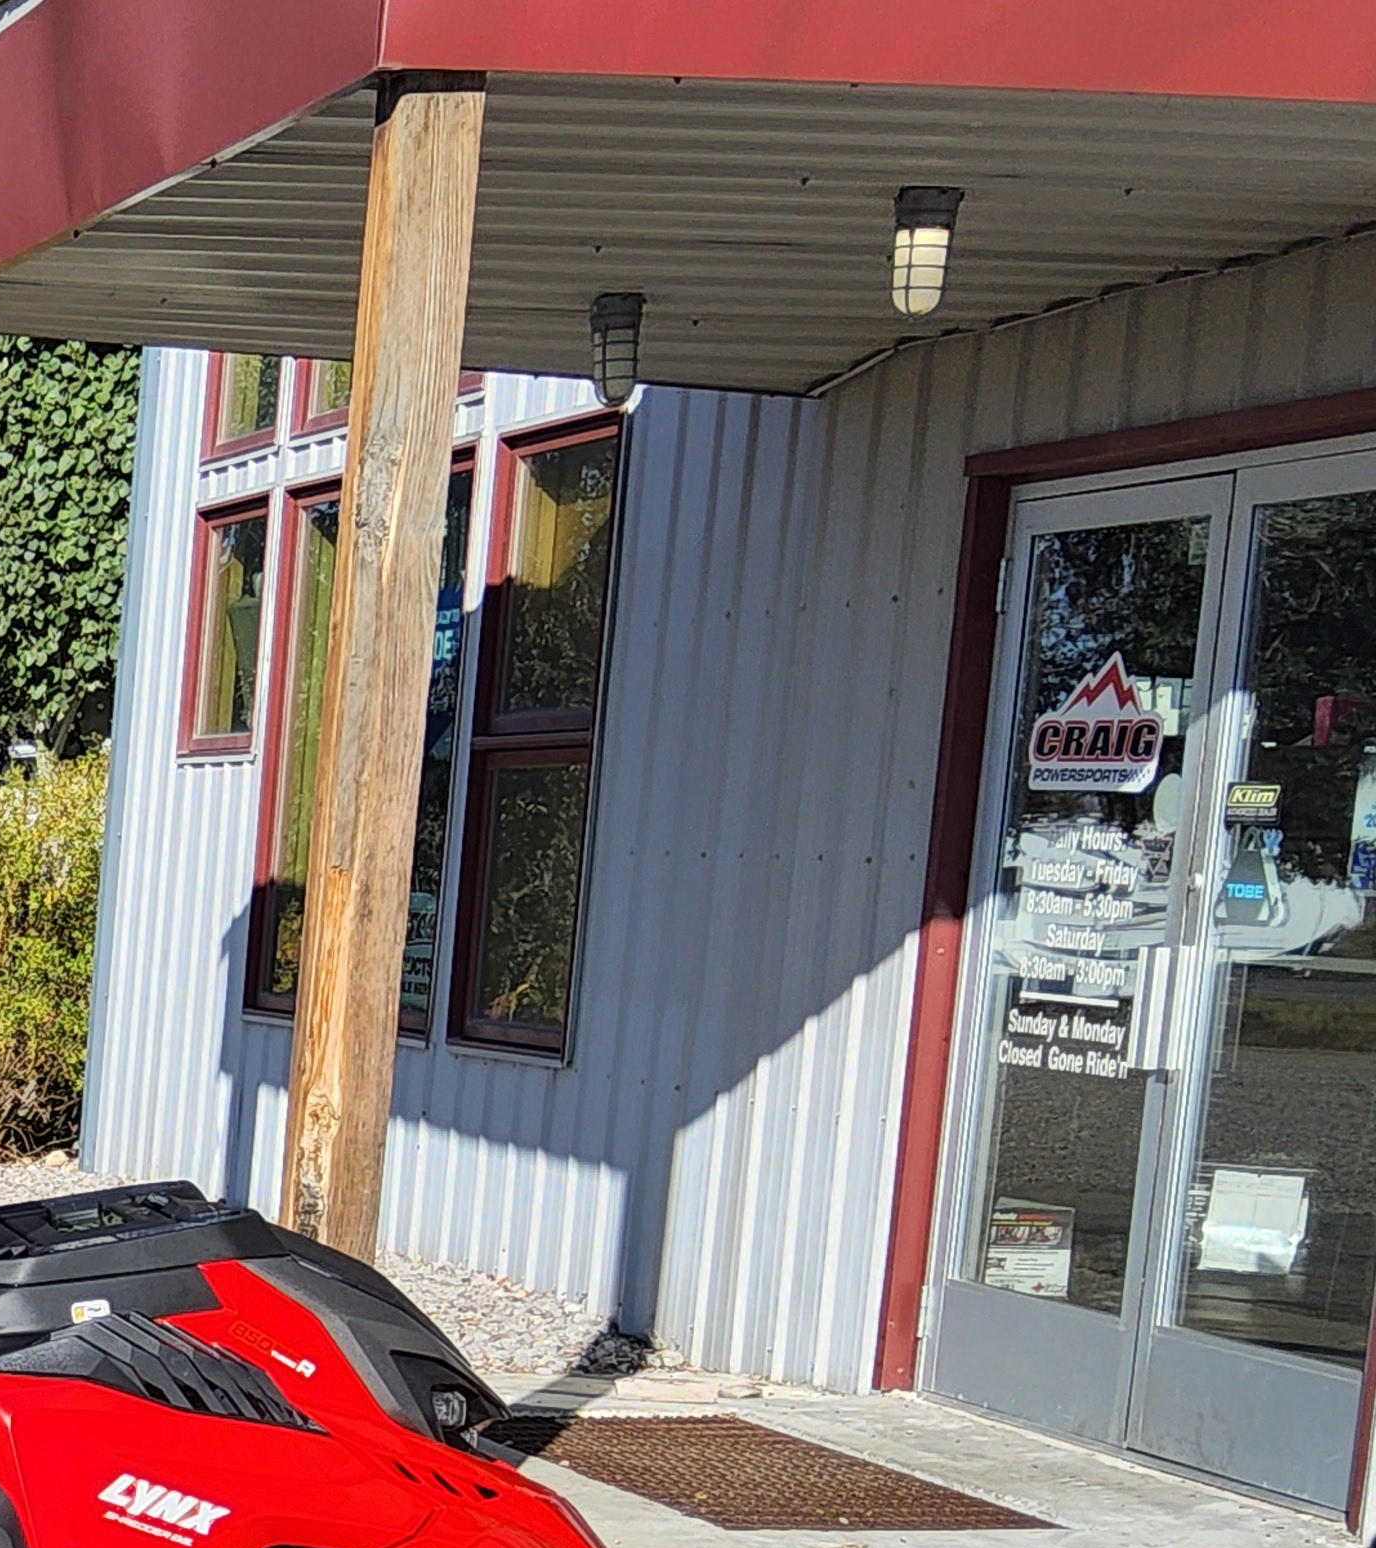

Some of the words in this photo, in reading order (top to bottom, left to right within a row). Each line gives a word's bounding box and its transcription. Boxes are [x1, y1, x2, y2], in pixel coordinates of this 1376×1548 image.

[1033, 718, 1161, 763] CRAIG
[1033, 768, 1128, 783] POWERSPORTS
[1081, 826, 1129, 851] Hours:
[1031, 859, 1085, 888] Tuesday
[1095, 860, 1139, 892] Friday
[1226, 882, 1265, 899] TOBE
[1026, 891, 1073, 915] 8:30am
[1082, 894, 1133, 924] 5:30pm
[1047, 924, 1106, 957] Saturday
[1019, 956, 1066, 981] 8:30am
[1075, 961, 1125, 991] 3:00pm
[1008, 1009, 1057, 1042] Sunday
[1058, 1014, 1070, 1039] &
[1071, 1016, 1126, 1051] Monday
[999, 1040, 1044, 1068] Closed
[1048, 1046, 1084, 1073] Gone
[1085, 1051, 1129, 1080] Ride'n
[97, 1473, 231, 1536] LYNX
